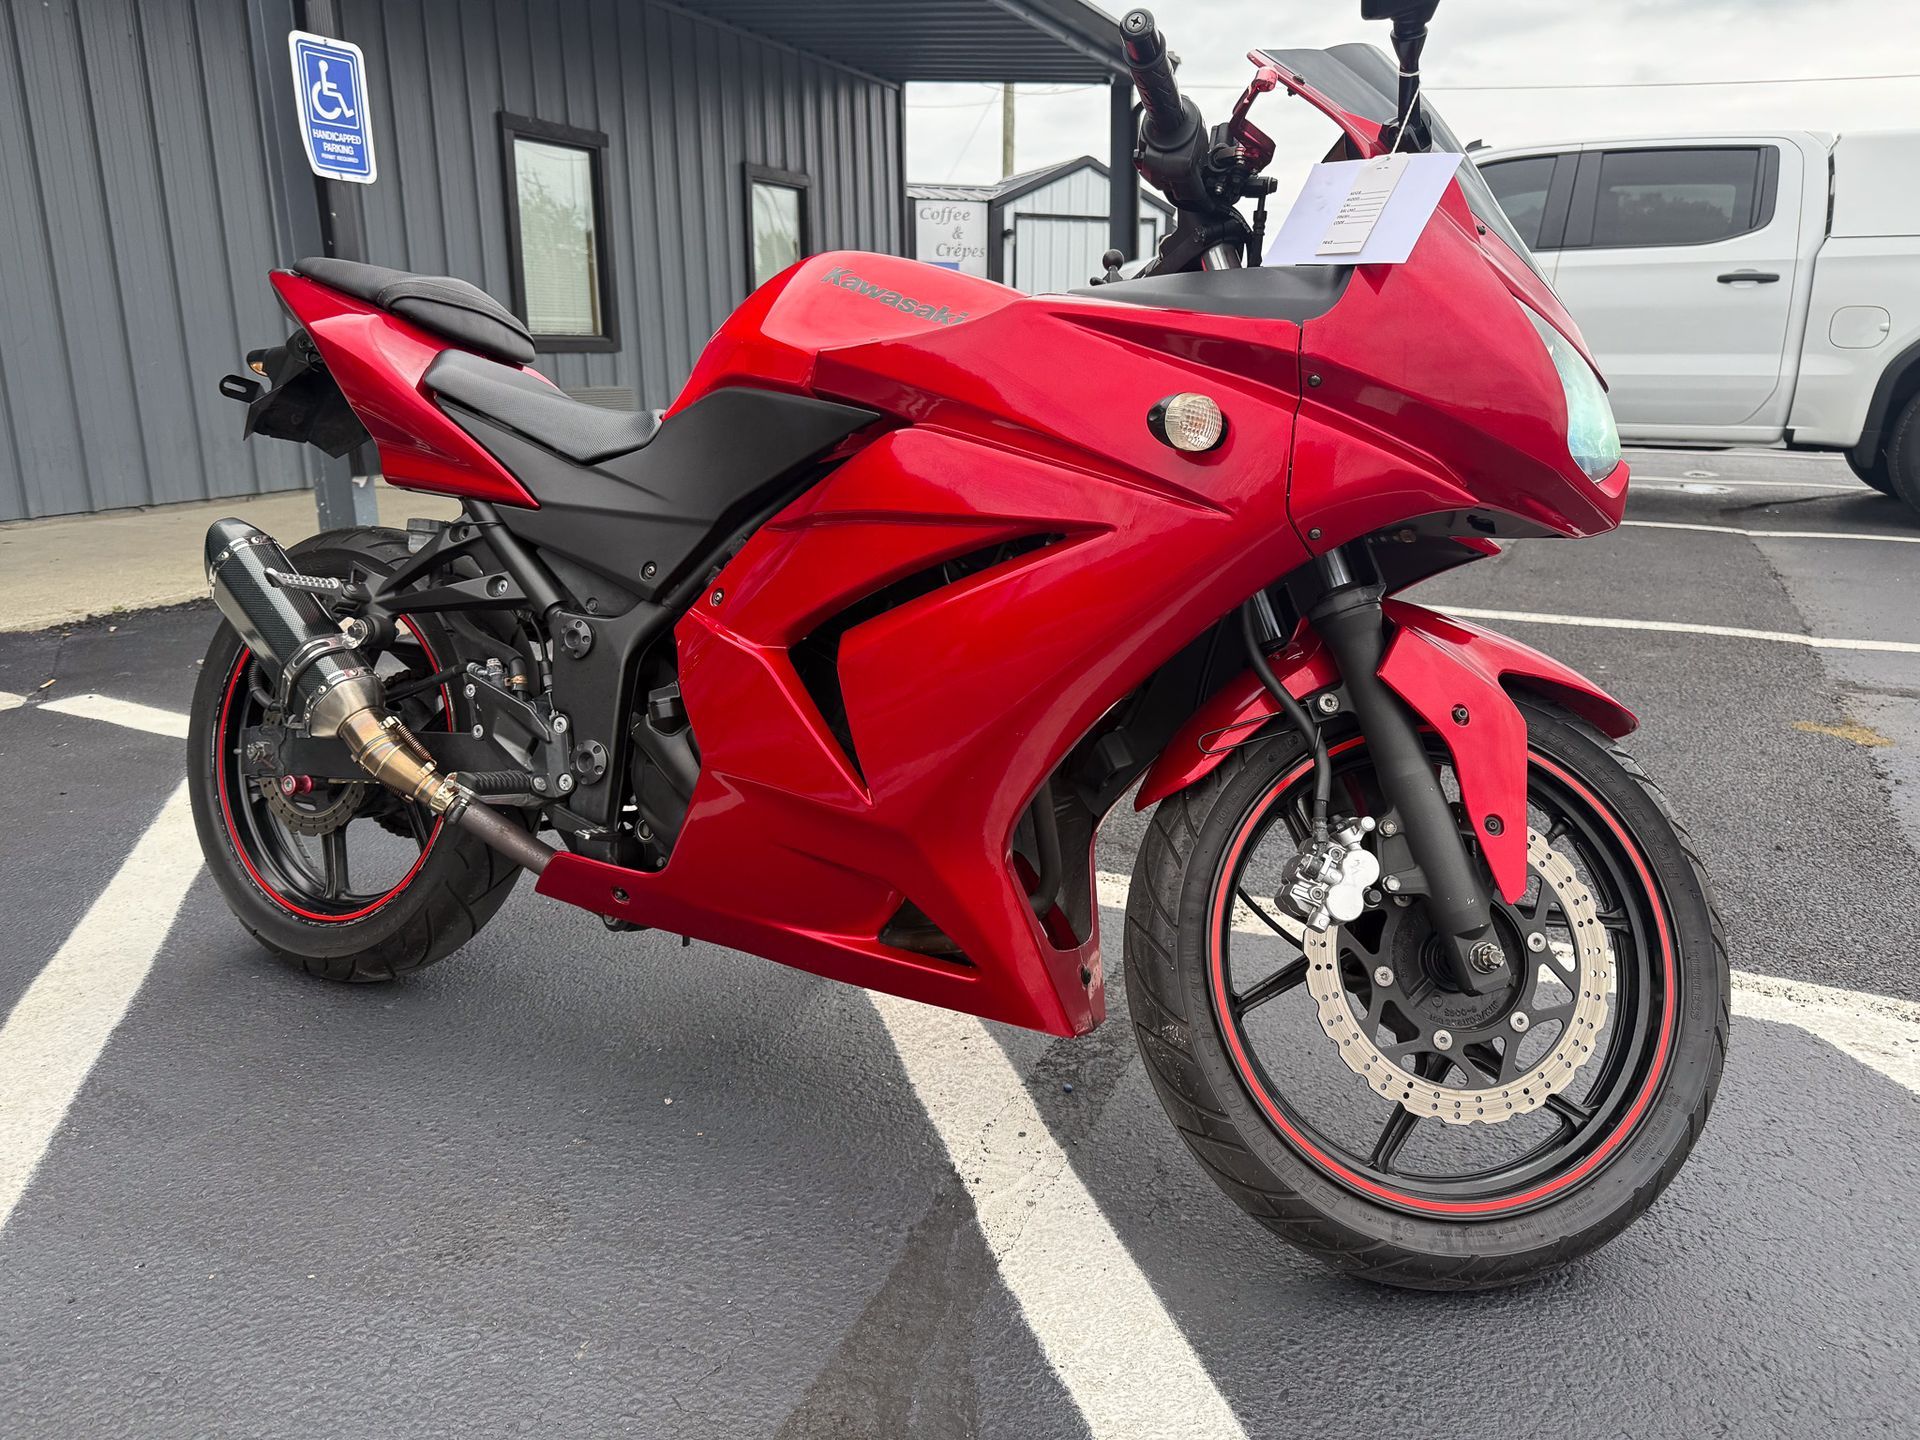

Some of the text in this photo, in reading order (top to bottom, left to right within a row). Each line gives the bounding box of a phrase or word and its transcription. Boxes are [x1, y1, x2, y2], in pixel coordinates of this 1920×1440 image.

[312, 129, 361, 144] HANDICAPPED
[323, 142, 354, 155] PARKING
[919, 206, 971, 226] Coffee
[951, 225, 964, 240] &
[935, 242, 986, 263] Crêpes
[821, 267, 969, 325] Kawasaki
